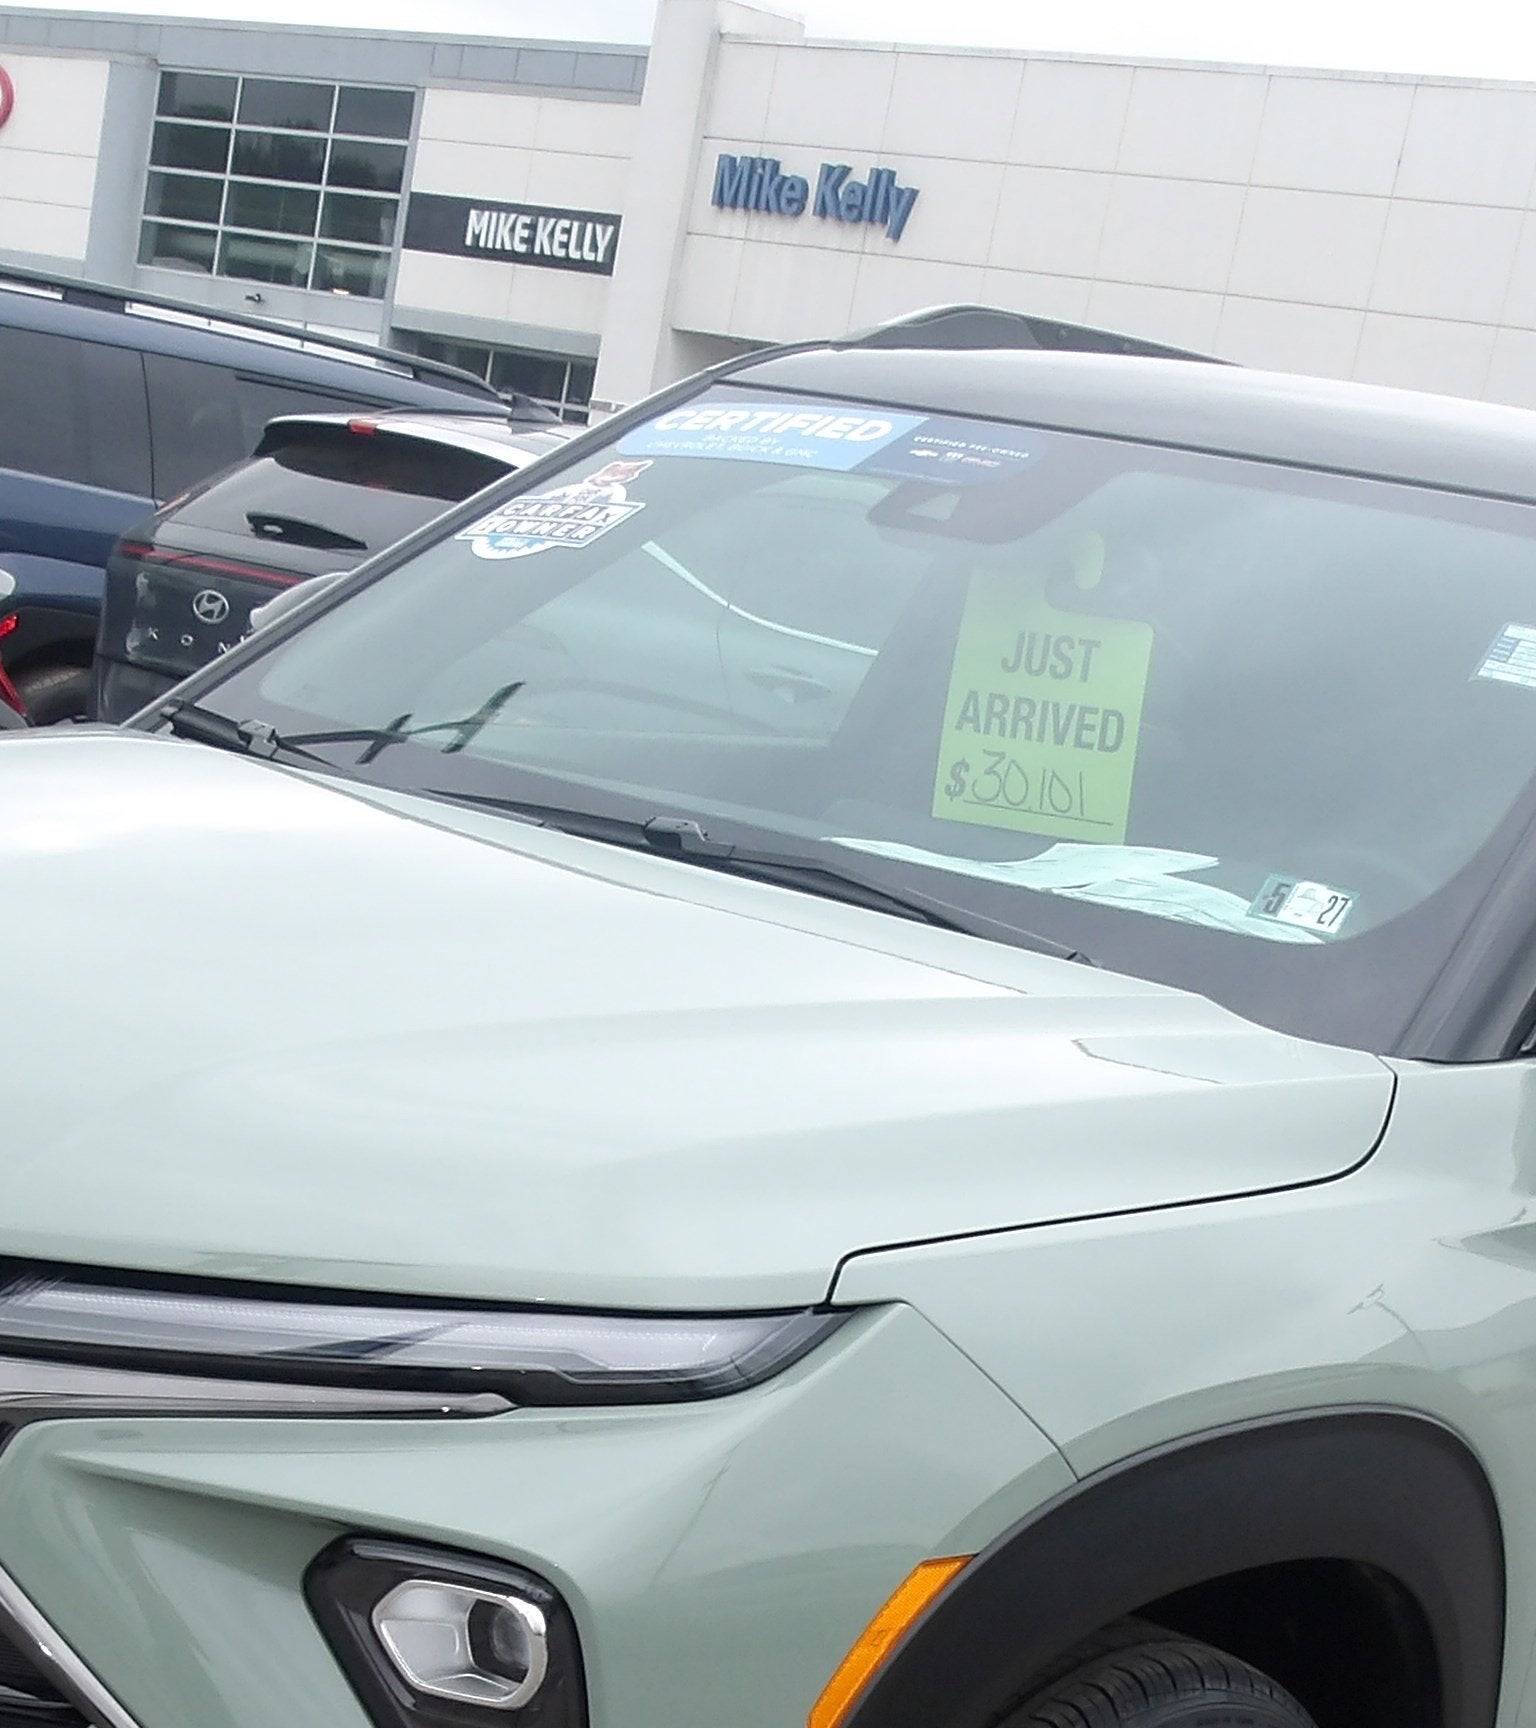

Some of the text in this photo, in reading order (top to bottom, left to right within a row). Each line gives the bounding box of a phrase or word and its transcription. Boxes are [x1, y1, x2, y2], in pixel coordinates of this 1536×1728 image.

[711, 153, 919, 243] Mike Kelly
[464, 208, 614, 264] MIKE KELLY
[654, 409, 893, 442] CERTIFIED
[1001, 630, 1101, 683] JUST
[954, 690, 1125, 753] ARRIVED
[1316, 895, 1351, 927] 27
